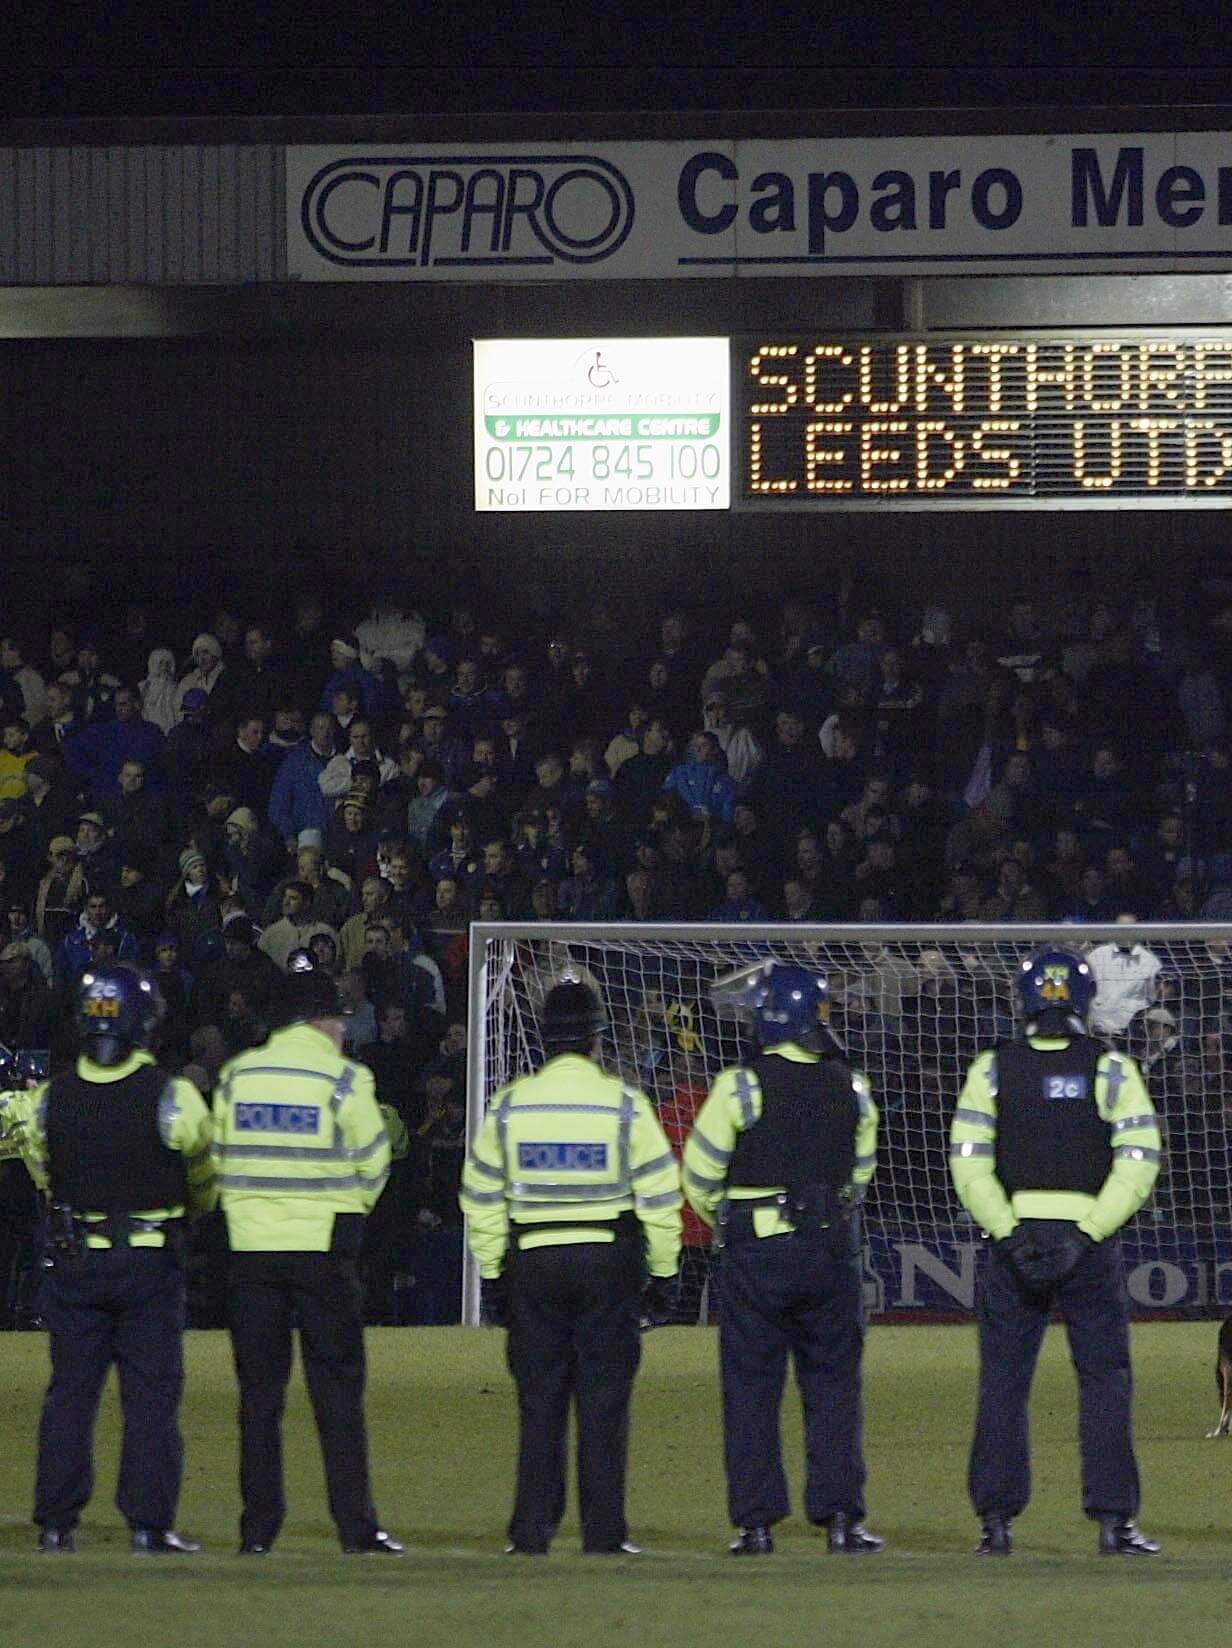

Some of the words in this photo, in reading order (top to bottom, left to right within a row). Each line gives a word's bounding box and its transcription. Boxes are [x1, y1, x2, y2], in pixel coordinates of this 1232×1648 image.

[312, 166, 624, 266] CAPARO
[677, 152, 1024, 254] Caparo
[516, 419, 632, 437] HEALTHCARE
[637, 418, 711, 436] CENTRE
[486, 445, 575, 482] 01724
[592, 445, 653, 480] 845
[671, 444, 720, 480] 100
[751, 421, 1021, 490] LEEDS
[539, 488, 591, 505] FOR
[604, 486, 720, 505] MOBILITY
[236, 1104, 317, 1133] POLICE
[520, 1144, 606, 1169] POLICE
